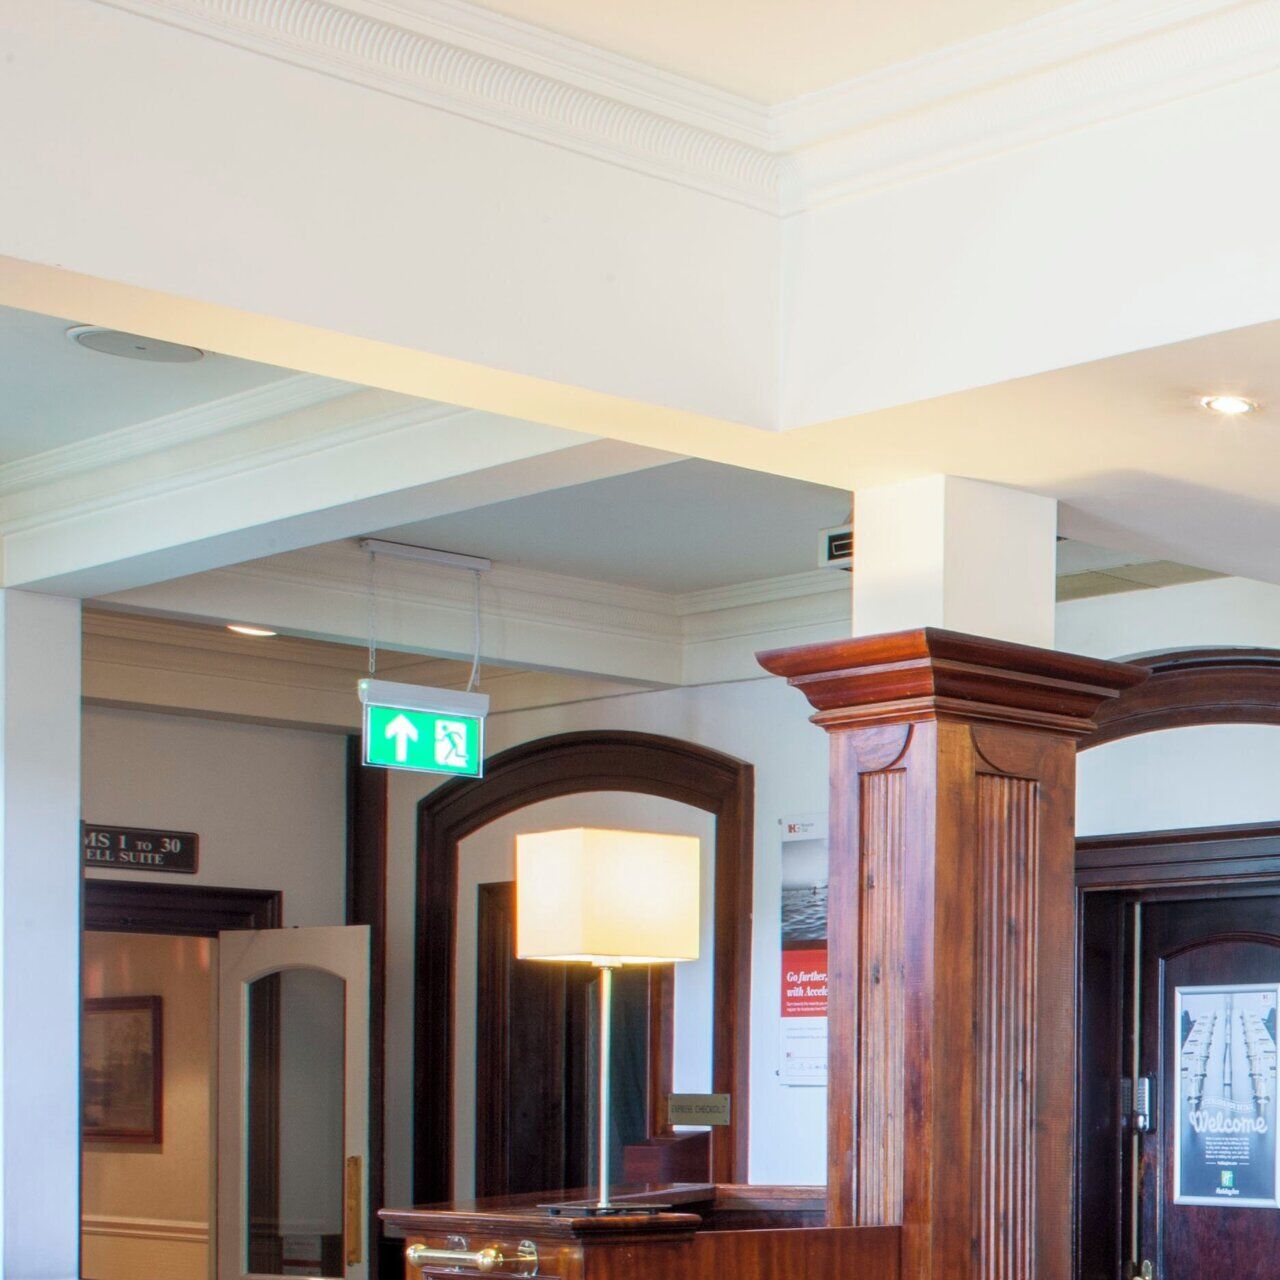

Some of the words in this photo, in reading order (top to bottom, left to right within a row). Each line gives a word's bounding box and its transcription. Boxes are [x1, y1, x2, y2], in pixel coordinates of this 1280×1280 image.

[160, 838, 181, 853] 30
[119, 851, 165, 865] SUITE
[787, 971, 798, 982] Go
[1189, 1109, 1268, 1134] Welcome
